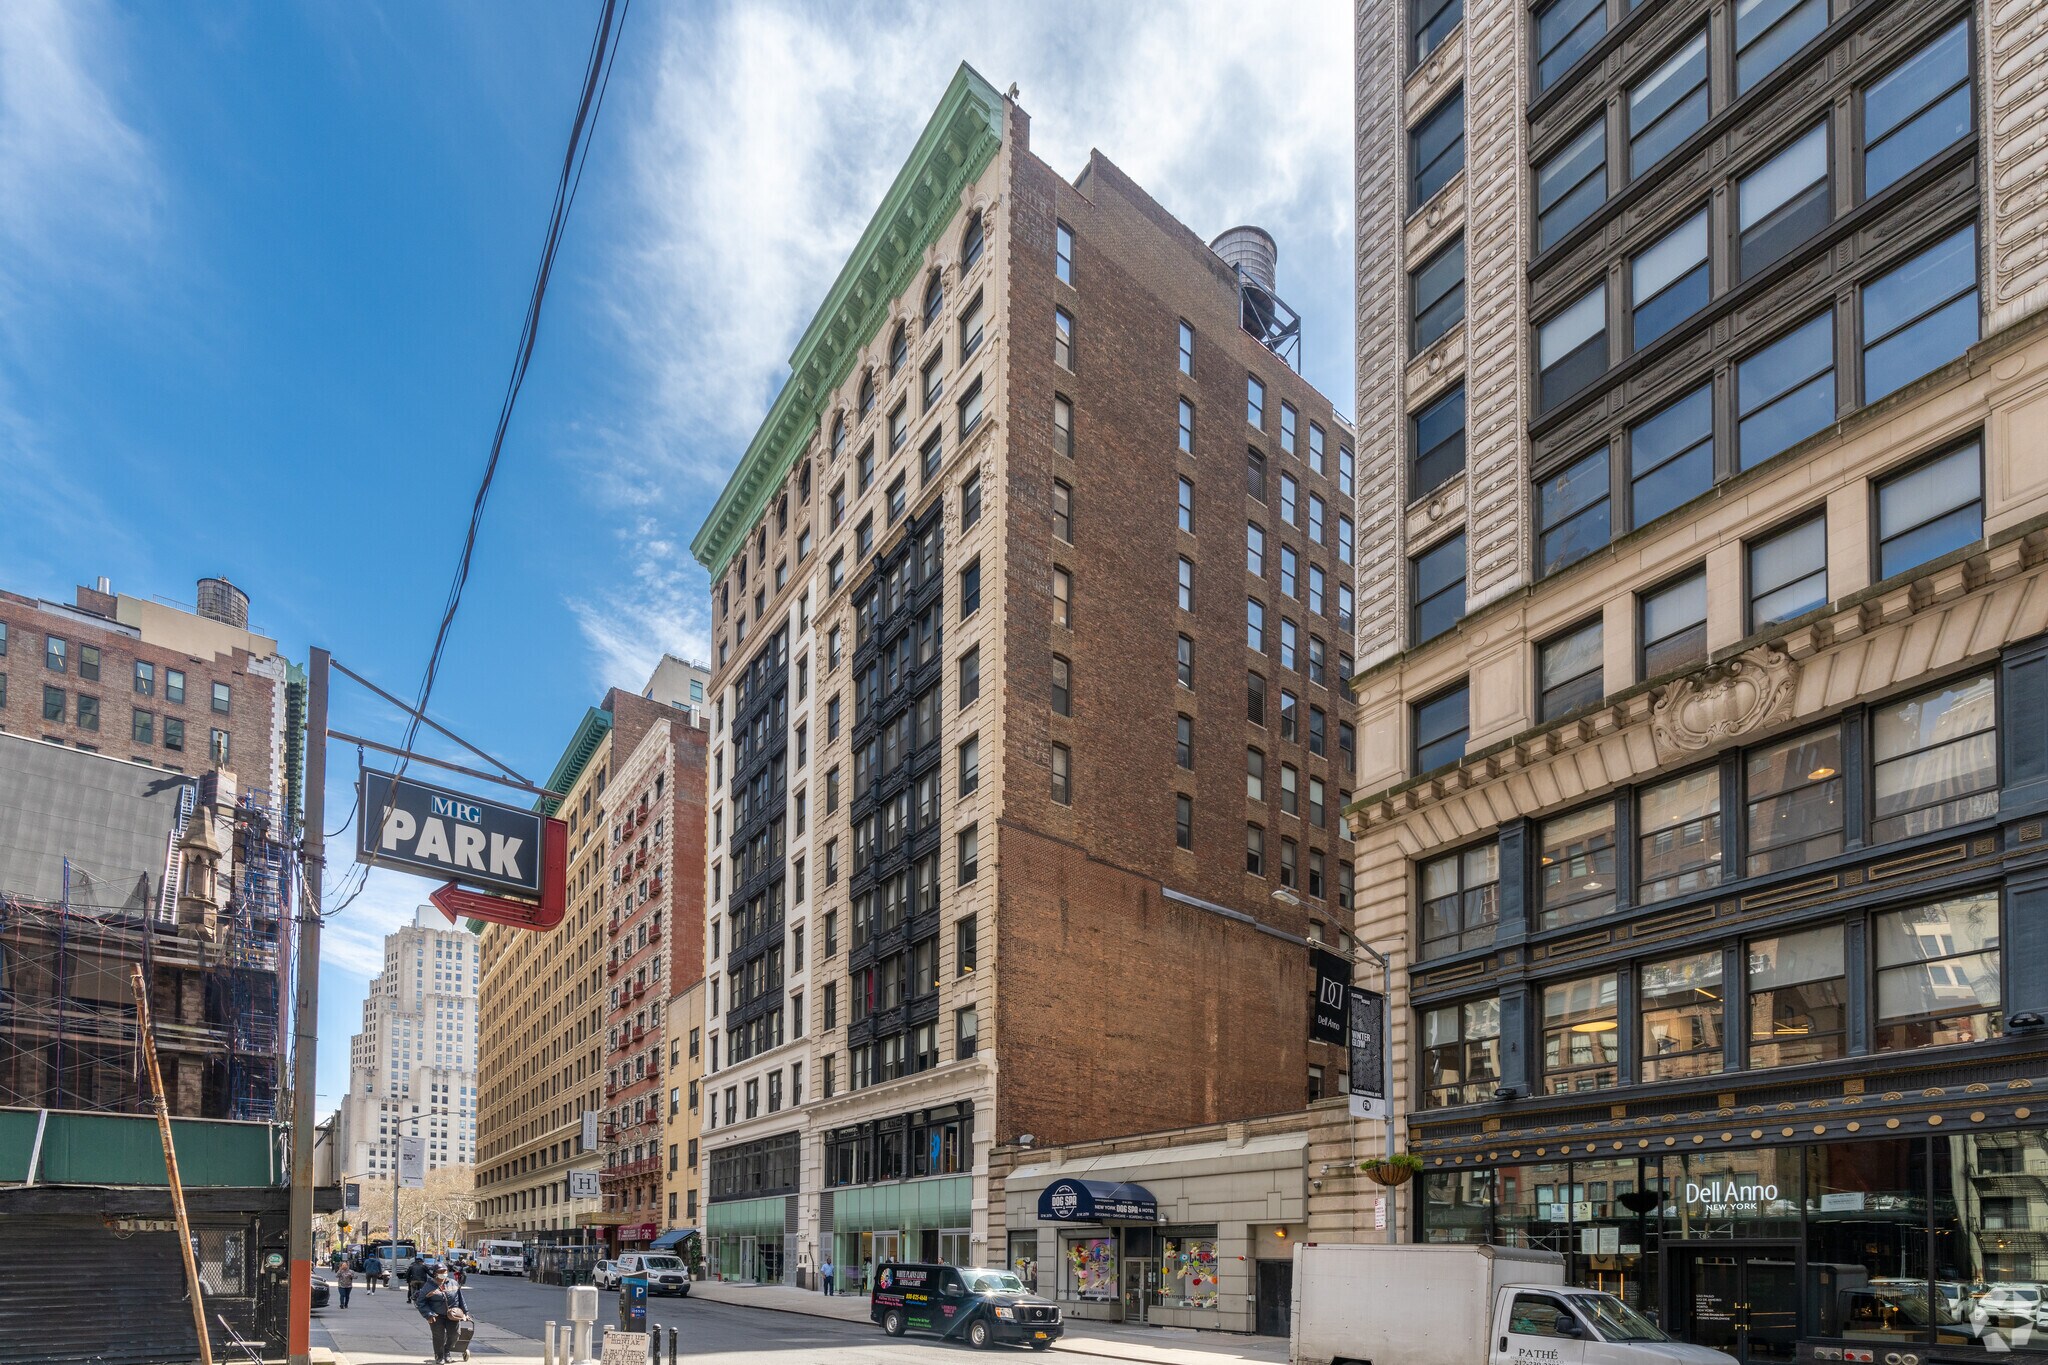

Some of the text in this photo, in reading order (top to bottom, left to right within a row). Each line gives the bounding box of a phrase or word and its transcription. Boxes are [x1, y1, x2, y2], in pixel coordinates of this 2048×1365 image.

[433, 796, 481, 824] MPG
[382, 805, 524, 880] PARK
[1318, 1014, 1340, 1031] Dell Anno
[1352, 1030, 1371, 1042] WINTER
[1352, 1038, 1366, 1049] GLOW
[579, 1178, 591, 1190] H
[1686, 1181, 1778, 1204] Dell Anno
[1052, 1195, 1077, 1206] DOG SPA
[1730, 1202, 1757, 1211] YORK
[1116, 1204, 1127, 1213] DOG
[1127, 1205, 1138, 1214] SPA
[636, 1287, 644, 1298] P
[1518, 1348, 1558, 1360] PATHÉ
